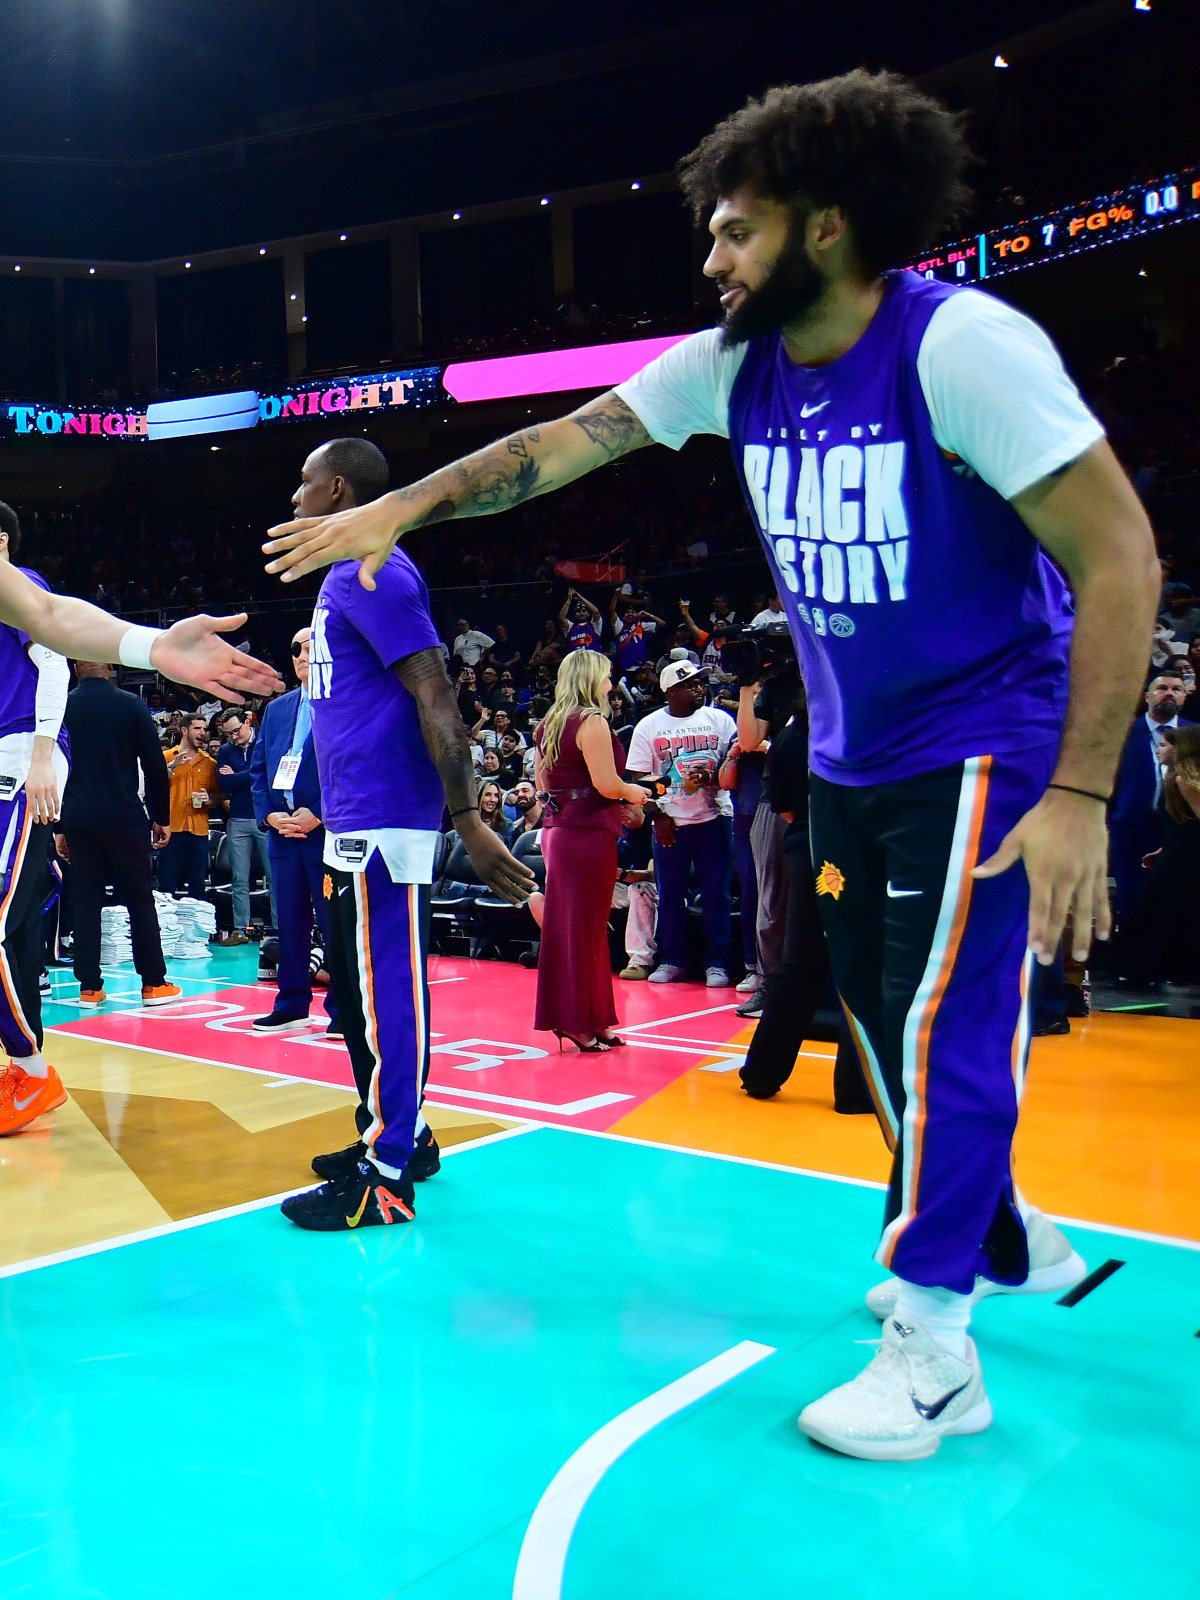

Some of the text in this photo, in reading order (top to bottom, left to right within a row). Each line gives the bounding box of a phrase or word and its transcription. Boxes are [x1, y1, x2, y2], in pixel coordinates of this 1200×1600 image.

[994, 236, 1031, 257] TO
[1042, 224, 1054, 246] 7
[1069, 205, 1133, 236] FG%
[1145, 186, 1178, 215] 0.0
[918, 247, 976, 271] STL BLK
[956, 261, 965, 277] 0
[258, 378, 414, 420] ONIGHT
[8, 406, 147, 435] TONIGH
[851, 424, 882, 439] BY
[743, 441, 909, 544] BLACK
[762, 538, 909, 604] STORY
[656, 725, 712, 737] SAN ANTONIO
[653, 734, 719, 775] SPURS
